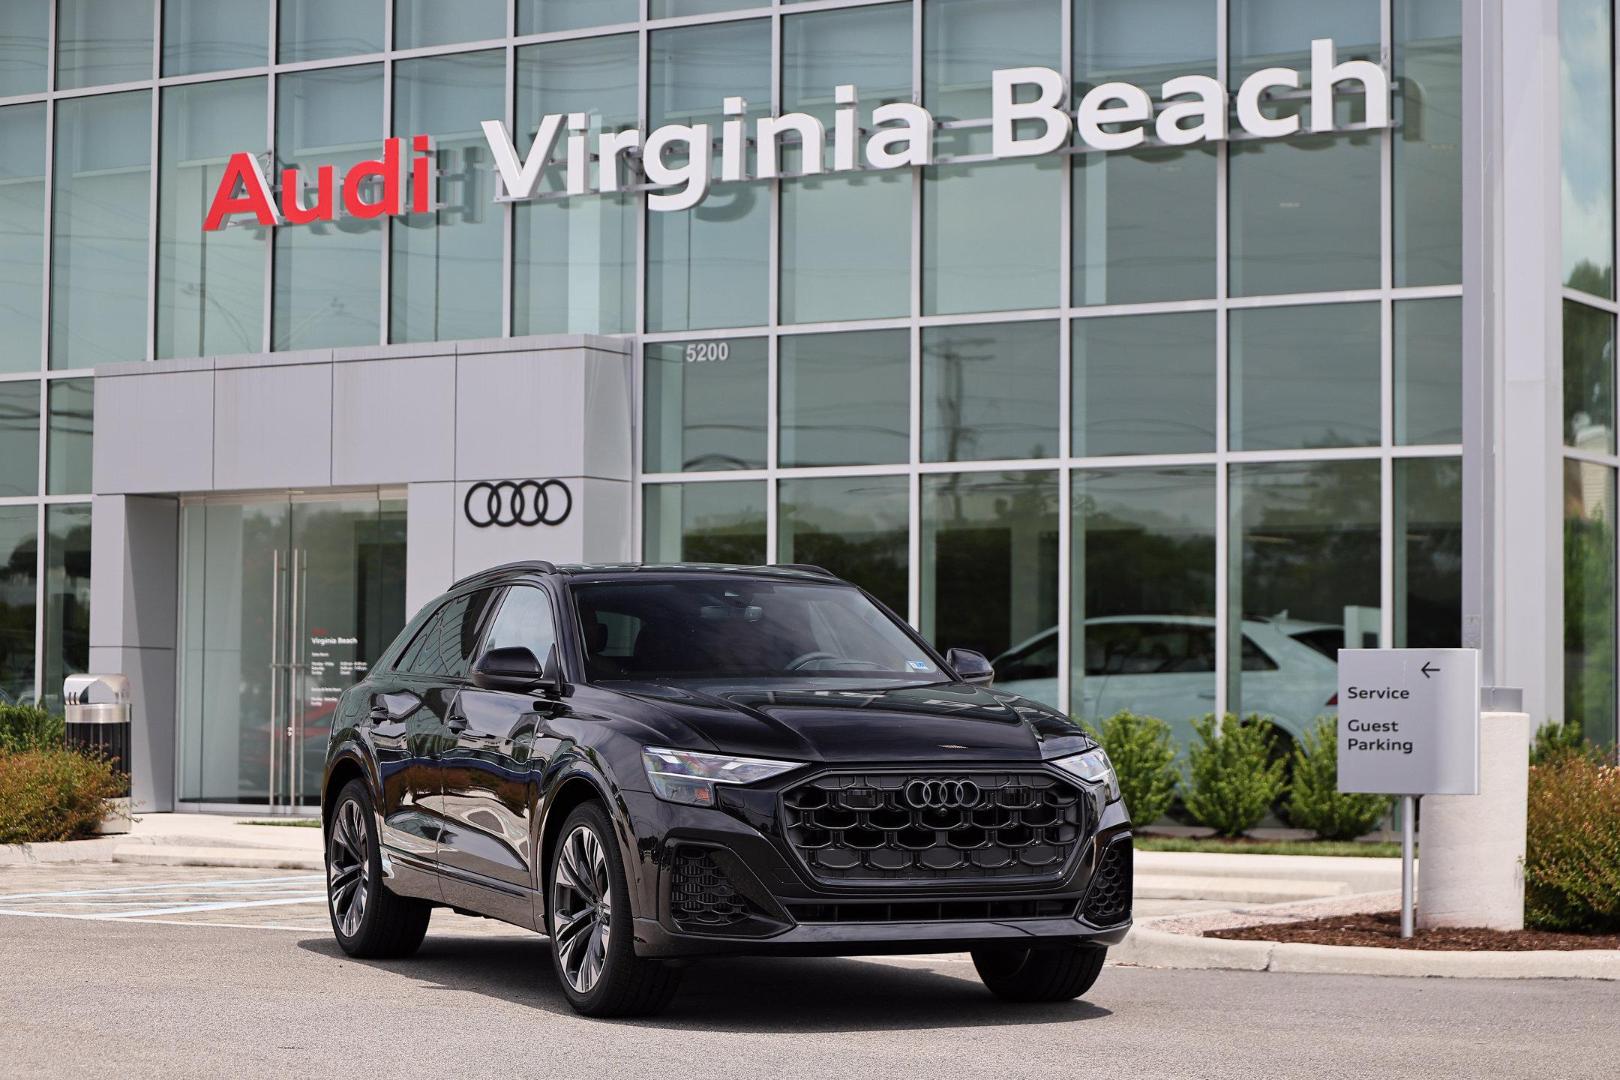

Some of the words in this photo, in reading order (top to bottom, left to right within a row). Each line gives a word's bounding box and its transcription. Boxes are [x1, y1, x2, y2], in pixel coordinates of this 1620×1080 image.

[202, 135, 433, 231] Audi
[480, 84, 932, 212] Virginia
[992, 38, 1389, 158] Beach
[686, 342, 729, 362] 5200
[1347, 686, 1410, 700] Service
[1347, 719, 1399, 733] Guest
[1347, 737, 1414, 755] Parking
